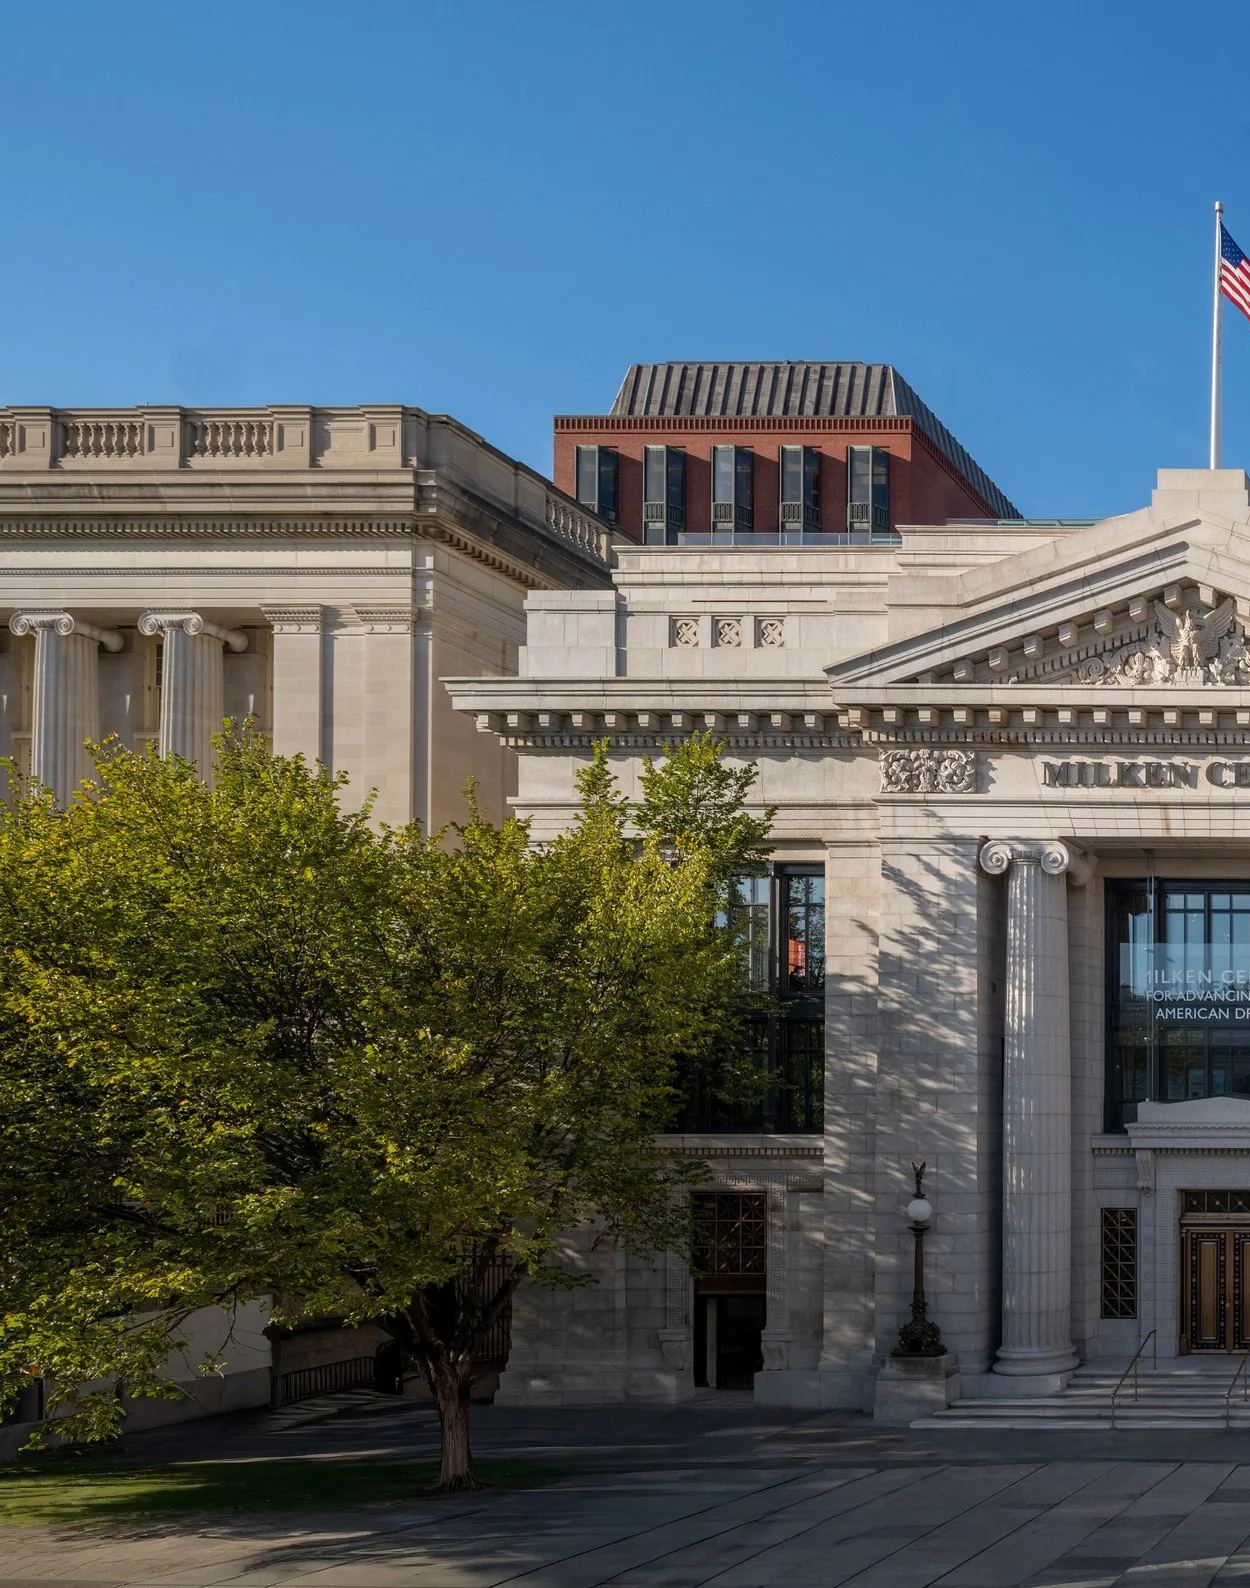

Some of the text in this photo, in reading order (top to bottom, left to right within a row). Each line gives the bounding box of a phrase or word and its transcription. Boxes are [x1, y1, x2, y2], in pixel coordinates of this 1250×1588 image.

[1041, 761, 1200, 788] MILKEN
[1146, 990, 1173, 1002] FOR
[1155, 1007, 1229, 1020] AMERICAN
